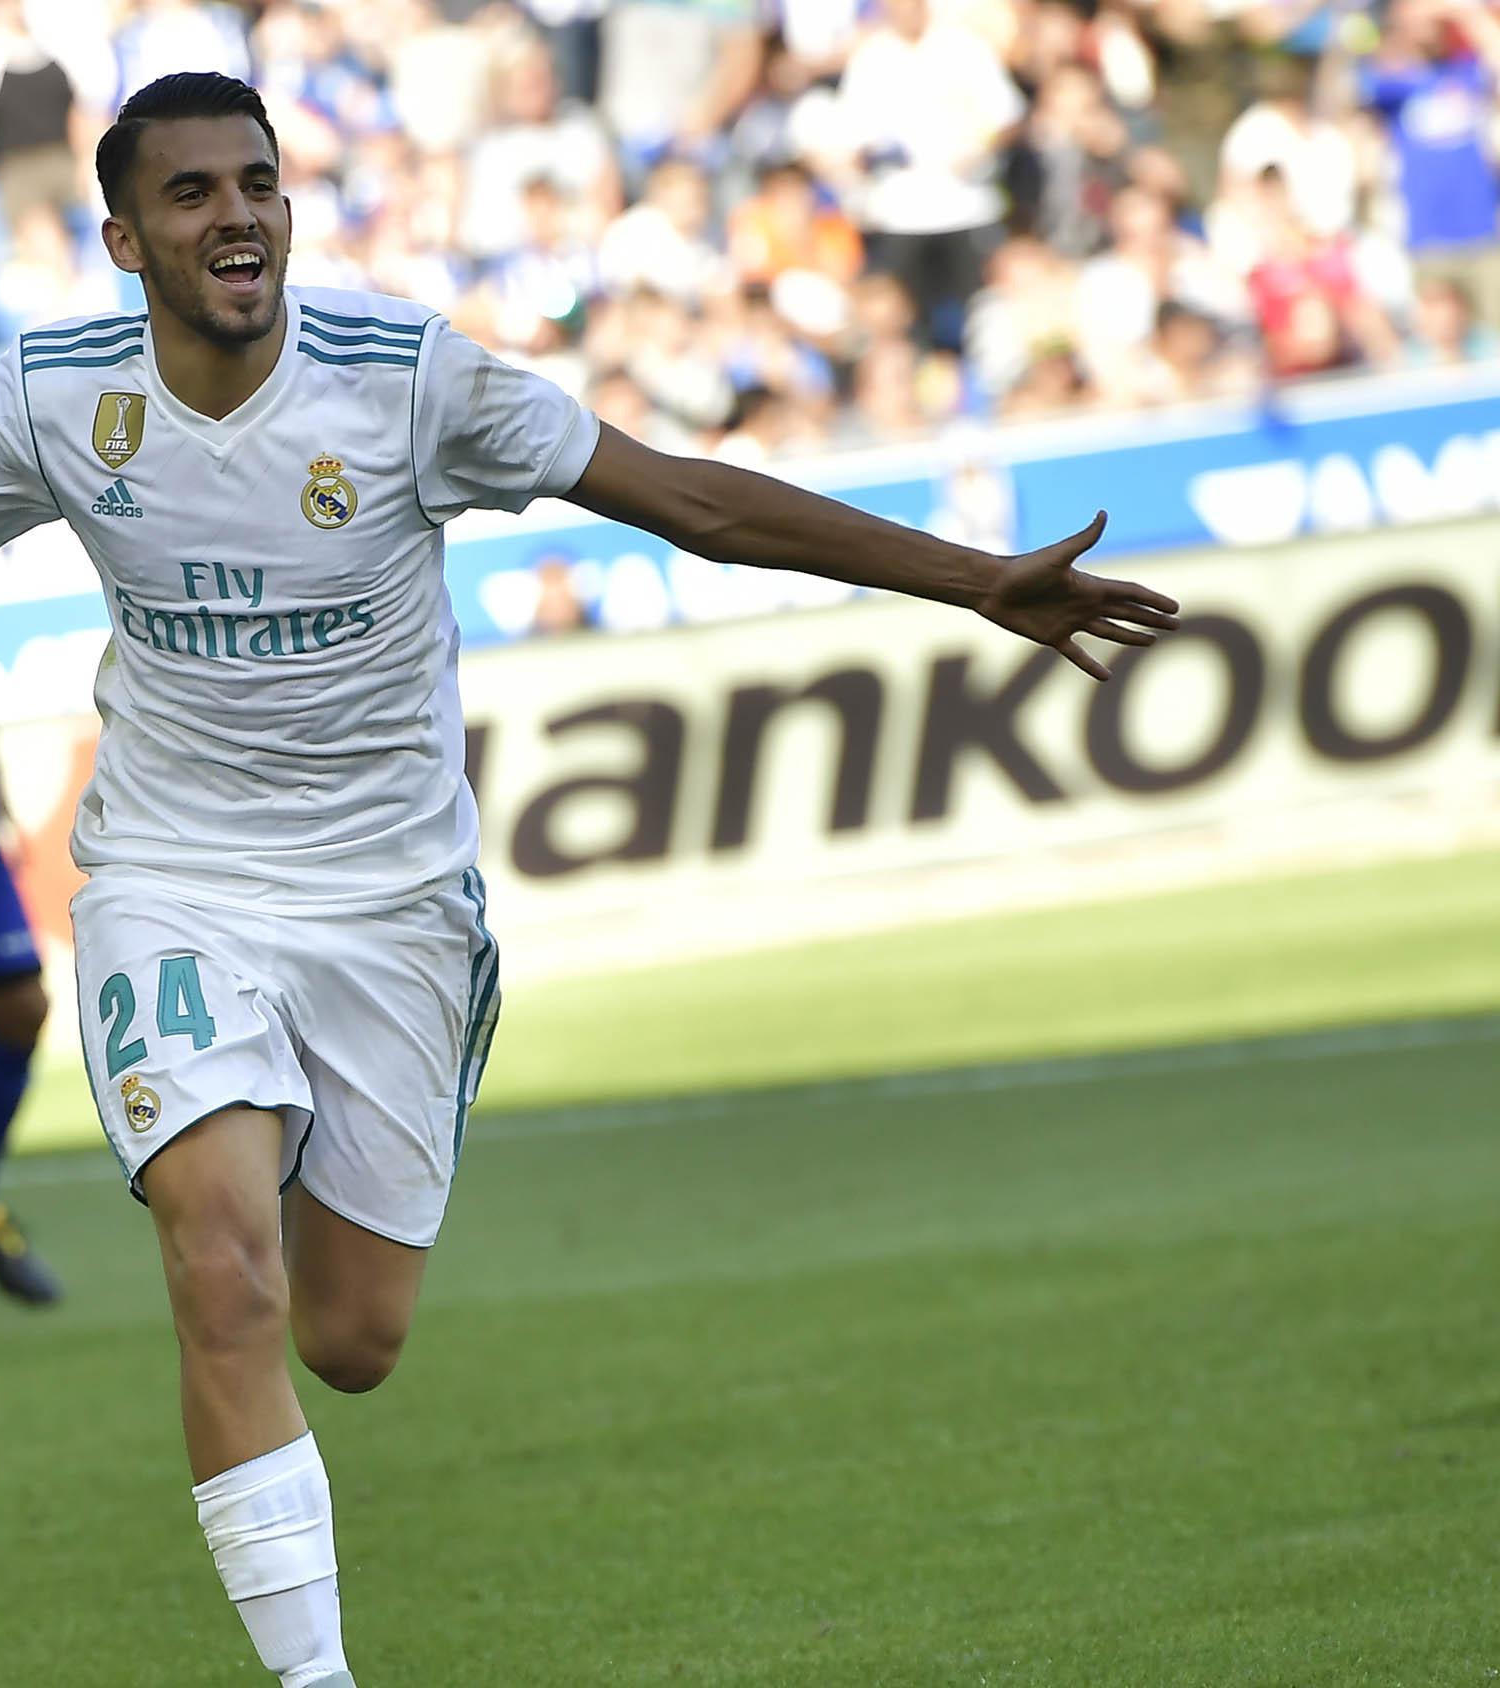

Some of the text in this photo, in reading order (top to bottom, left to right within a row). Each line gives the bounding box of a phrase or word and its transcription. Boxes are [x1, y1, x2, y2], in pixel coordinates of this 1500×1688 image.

[105, 440, 128, 450] FIFA
[92, 501, 143, 518] adidas
[180, 562, 263, 608] Fly
[116, 585, 375, 657] Emirates
[463, 572, 1500, 882] ankoo
[100, 956, 217, 1081] 24
